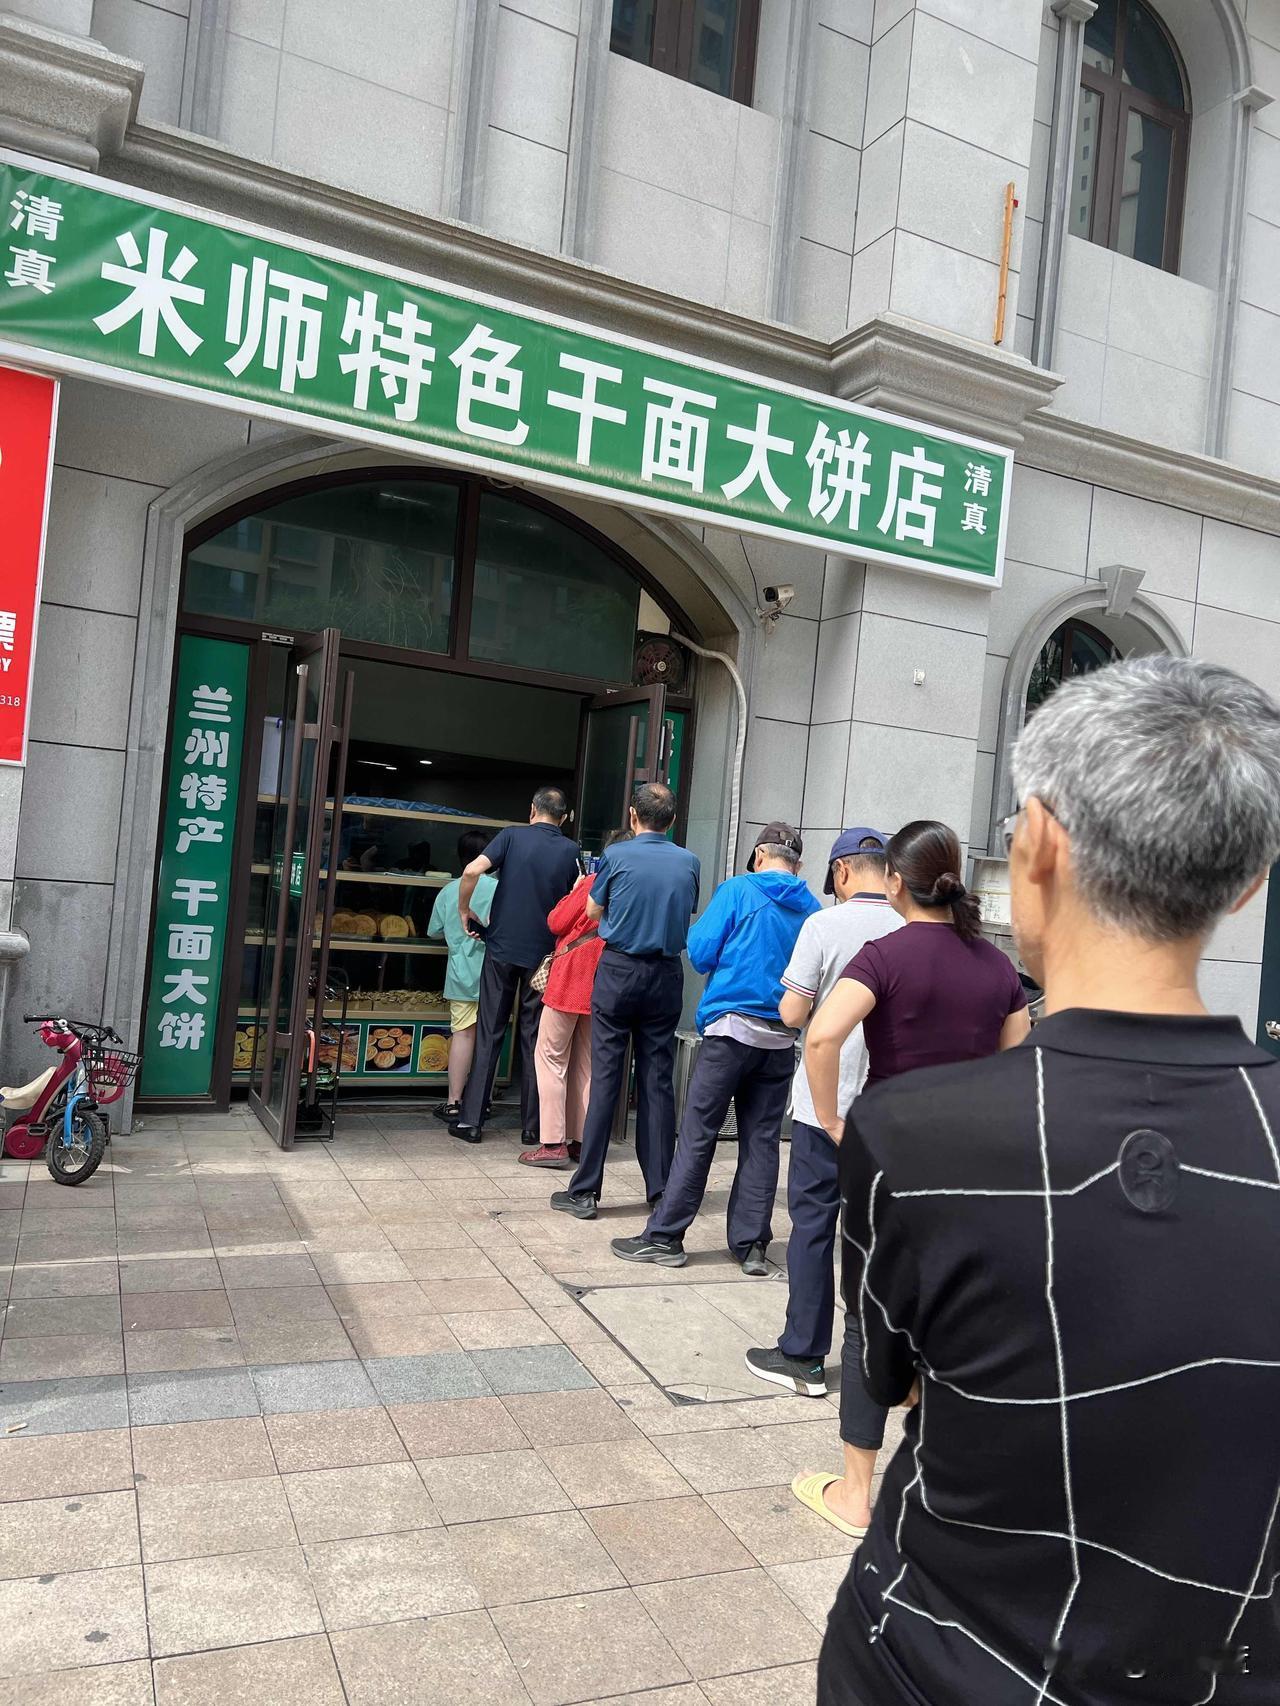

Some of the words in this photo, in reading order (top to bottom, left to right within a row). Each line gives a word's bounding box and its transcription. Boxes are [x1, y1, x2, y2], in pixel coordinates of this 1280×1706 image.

[4, 189, 65, 295] 清真
[92, 227, 945, 548] 米师特色干面大饼店
[960, 461, 993, 536] 清真
[176, 684, 233, 854] 兰州特产
[158, 878, 219, 1050] 干面大饼
